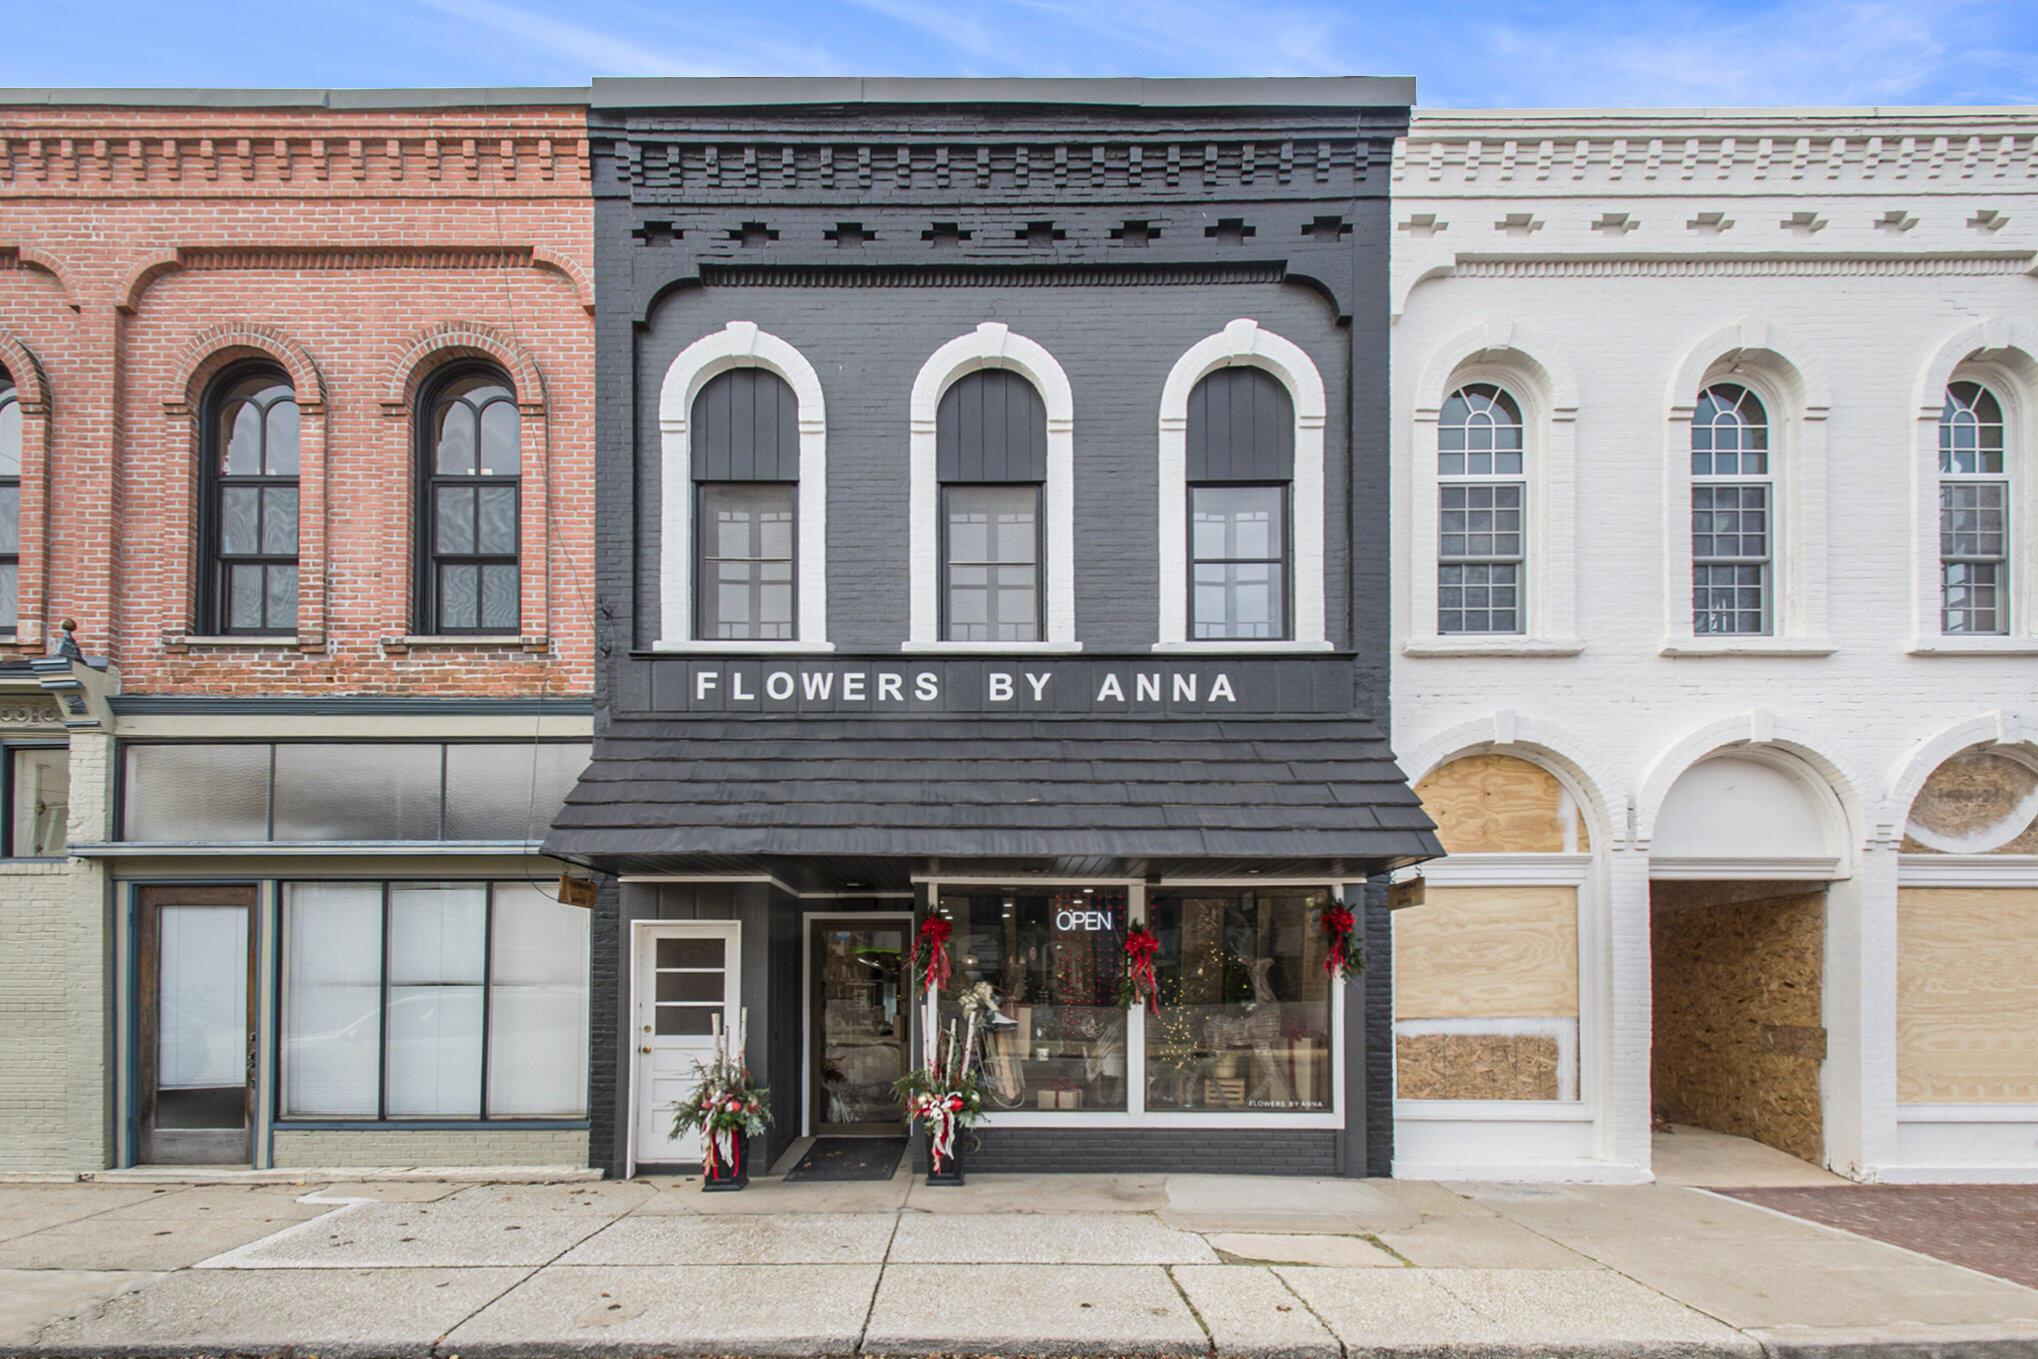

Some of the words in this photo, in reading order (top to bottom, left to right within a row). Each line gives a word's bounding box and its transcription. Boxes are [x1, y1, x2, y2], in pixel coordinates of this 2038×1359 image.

[696, 671, 940, 702] FLOWERS
[989, 672, 1052, 702] BY
[1096, 673, 1237, 702] ANNA
[1056, 911, 1112, 931] OPEN
[1248, 1100, 1286, 1108] FLOWERS
[1288, 1100, 1300, 1108] BY
[1301, 1100, 1324, 1108] ANNA
